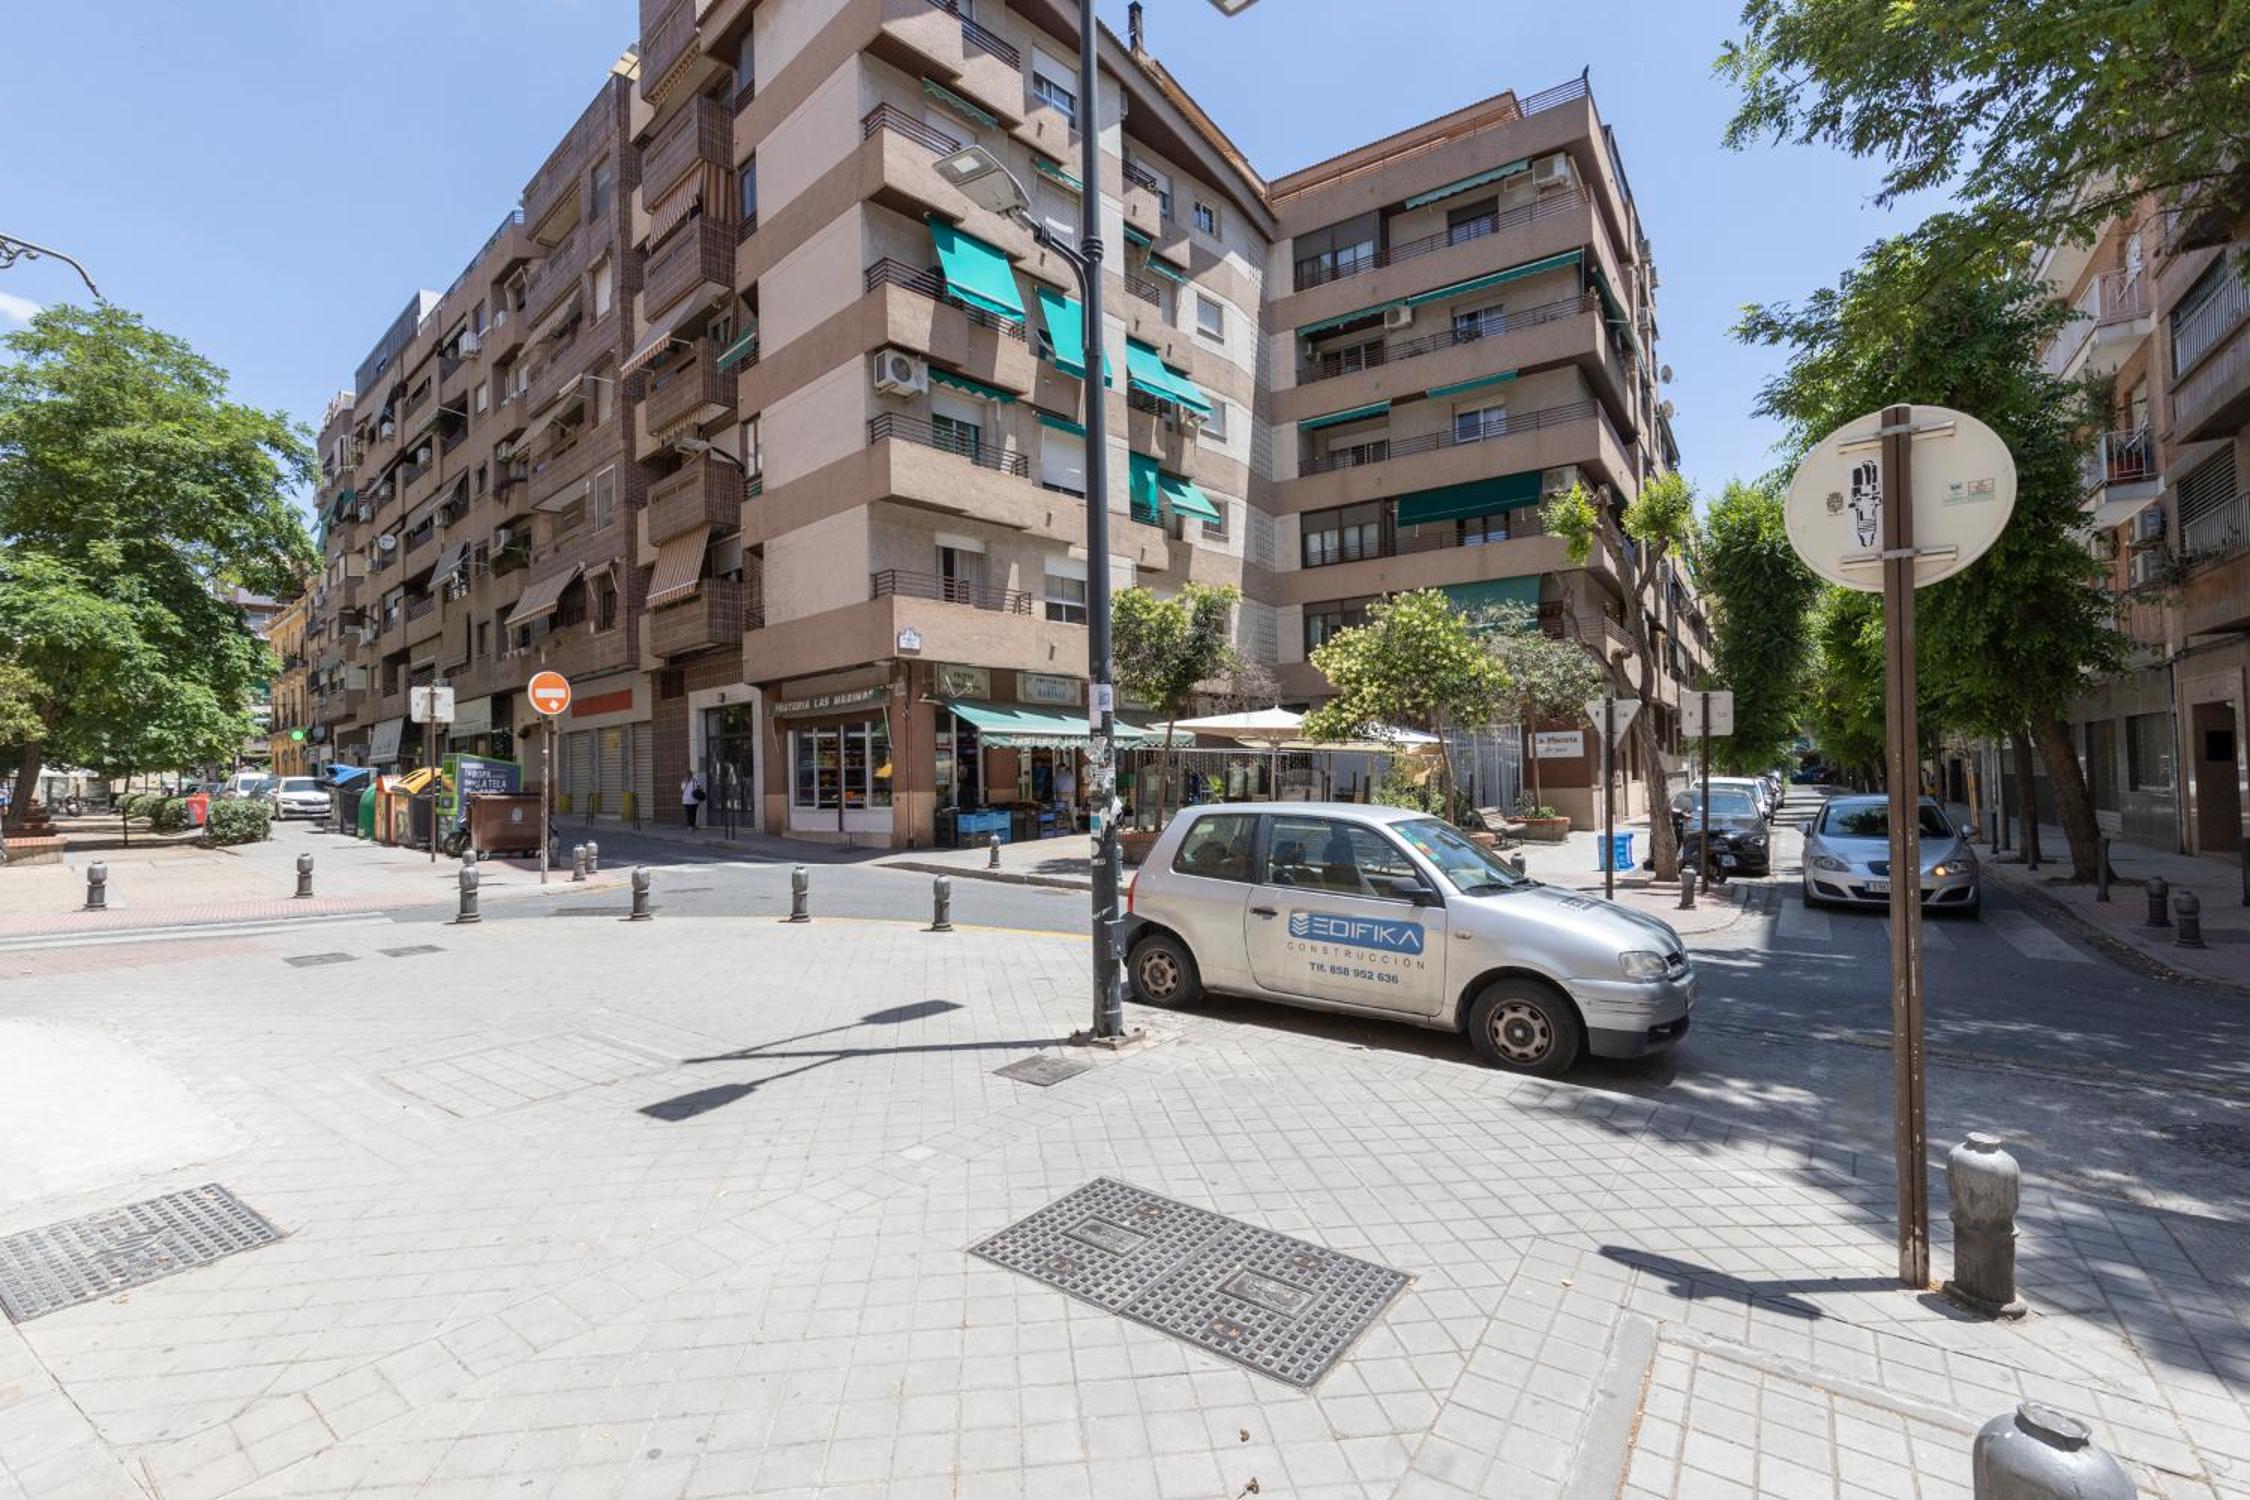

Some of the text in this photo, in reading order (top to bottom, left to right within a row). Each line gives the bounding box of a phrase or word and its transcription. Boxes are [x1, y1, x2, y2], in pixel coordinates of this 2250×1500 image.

[813, 696, 830, 708] LAS
[1312, 917, 1421, 948] EDIFIKA
[1329, 965, 1350, 977] 858
[1353, 969, 1374, 981] 952
[1377, 973, 1399, 985] 636
